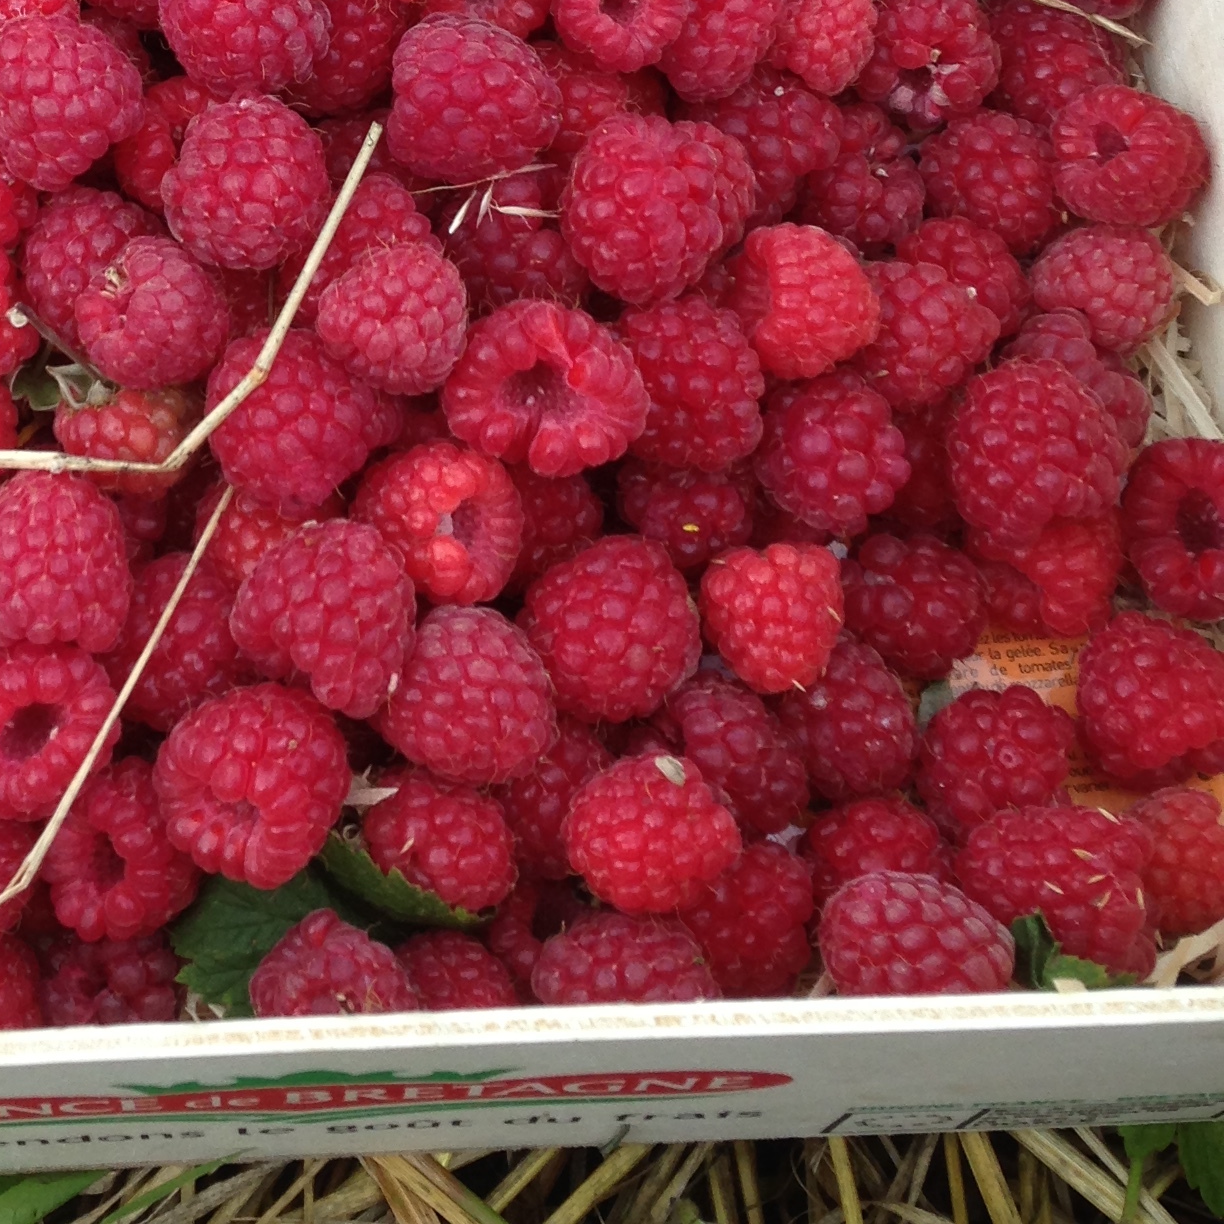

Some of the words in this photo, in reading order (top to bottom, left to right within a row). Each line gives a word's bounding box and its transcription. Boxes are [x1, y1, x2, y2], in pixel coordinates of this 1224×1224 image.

[1017, 658, 1073, 675] tomates
[183, 1094, 262, 1110] de
[286, 1075, 756, 1104] BRETAGNE
[237, 1127, 296, 1137] le
[325, 1118, 473, 1136] goût
[503, 1115, 582, 1125] du
[614, 1109, 764, 1123] frais
